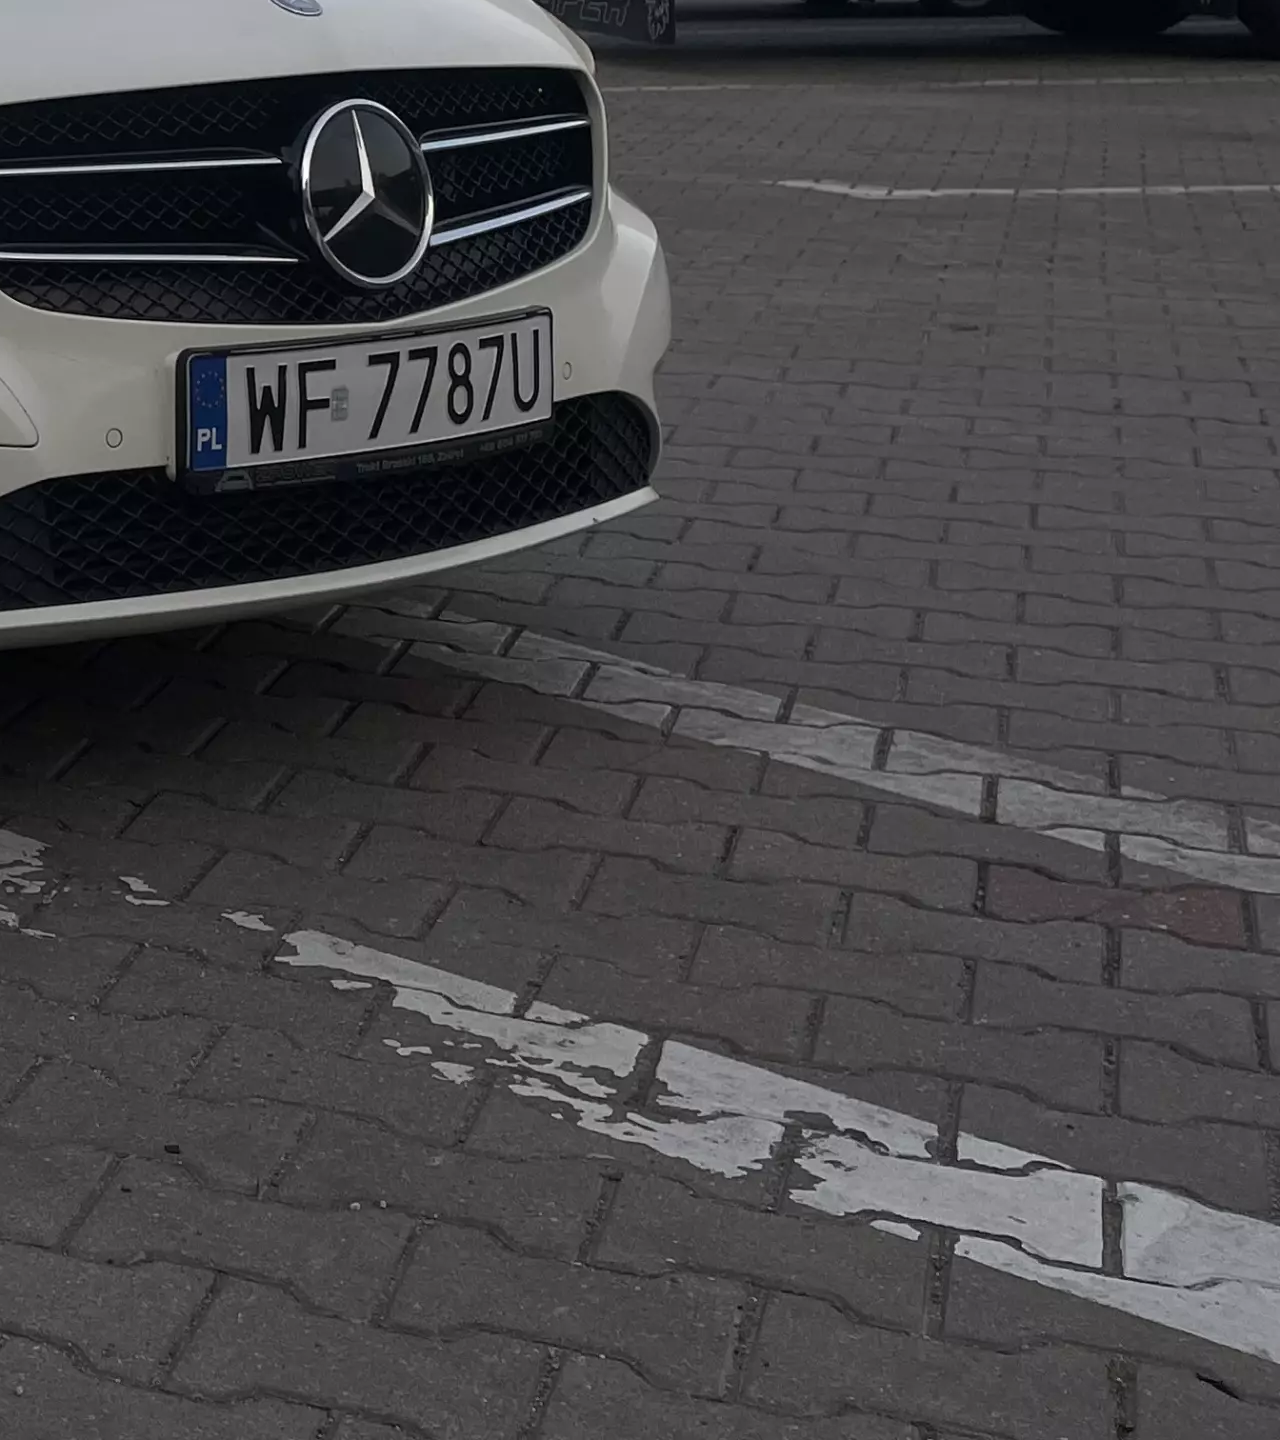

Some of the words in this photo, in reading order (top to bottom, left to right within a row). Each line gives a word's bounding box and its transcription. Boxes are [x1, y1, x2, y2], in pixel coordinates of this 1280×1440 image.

[245, 358, 337, 455] WF
[367, 328, 541, 440] 7787U
[196, 426, 223, 452] PL
